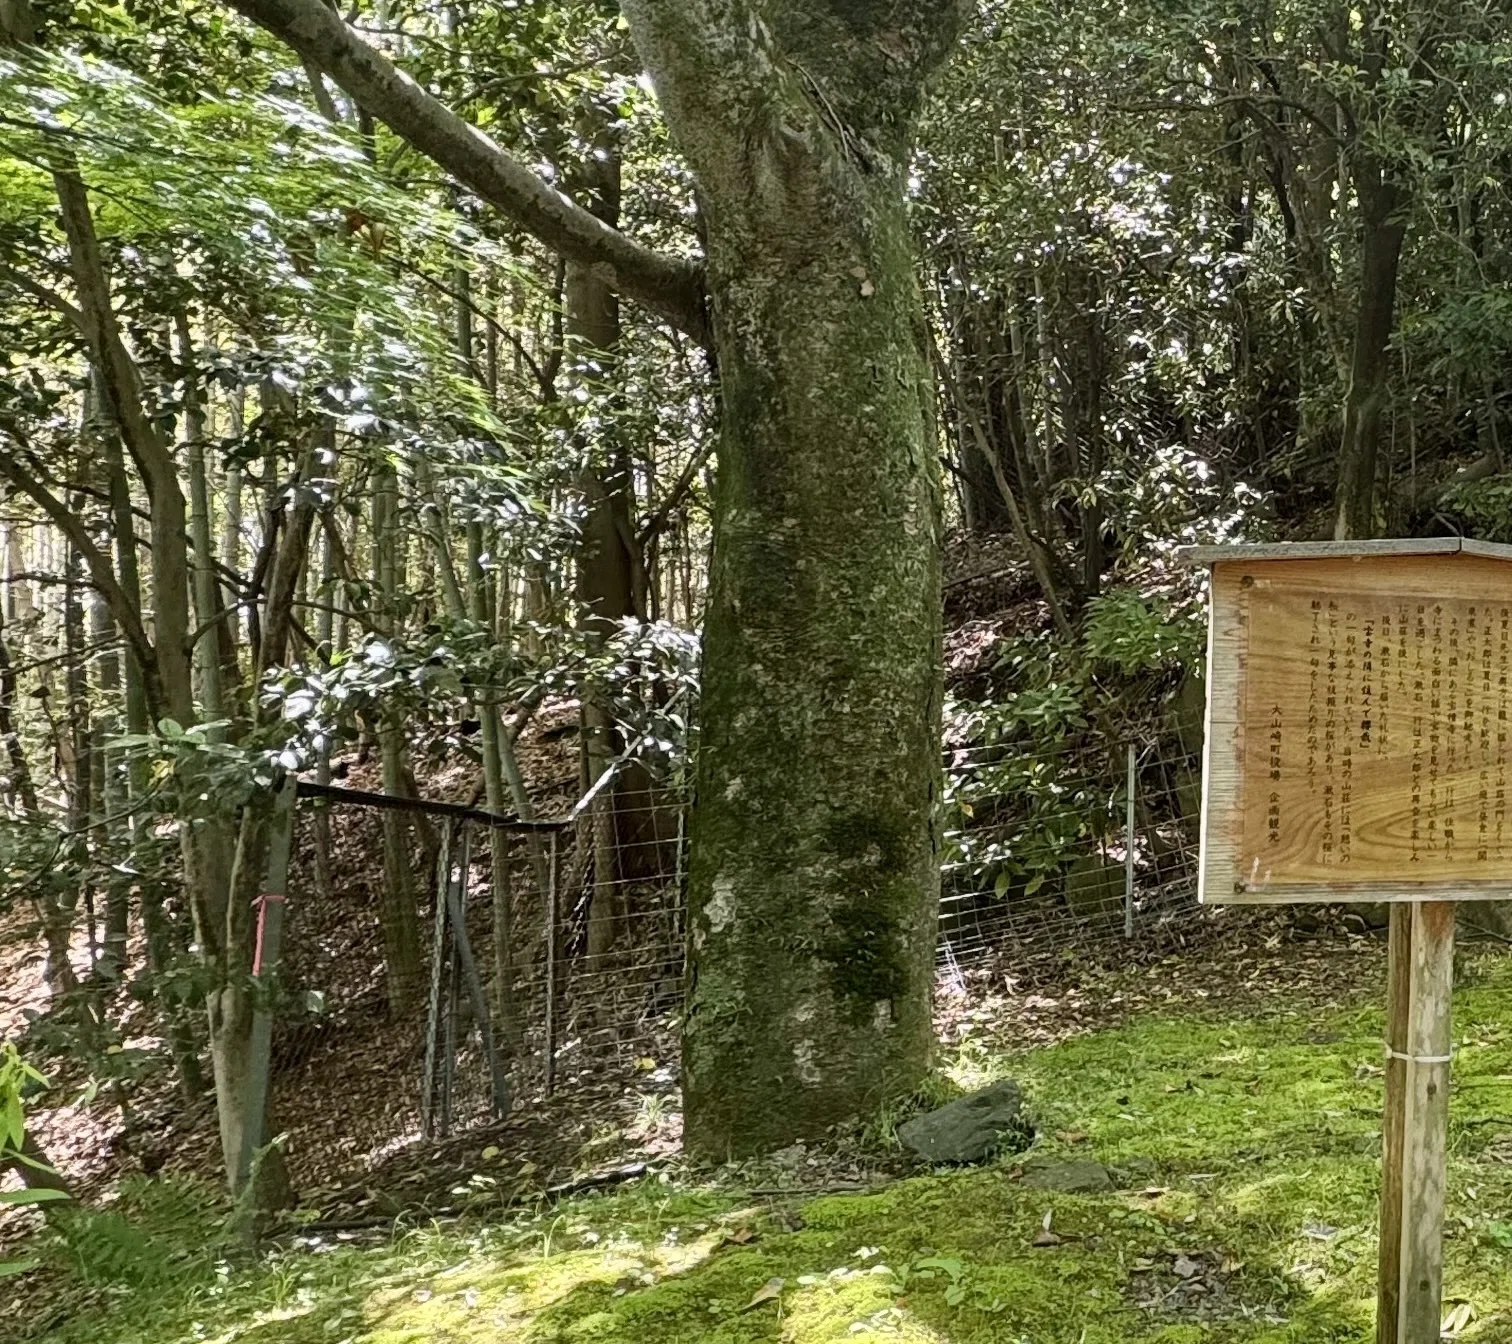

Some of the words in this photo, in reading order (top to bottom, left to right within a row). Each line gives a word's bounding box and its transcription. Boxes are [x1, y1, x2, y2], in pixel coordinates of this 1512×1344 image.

[1269, 705, 1283, 782] 大山崎町役場
